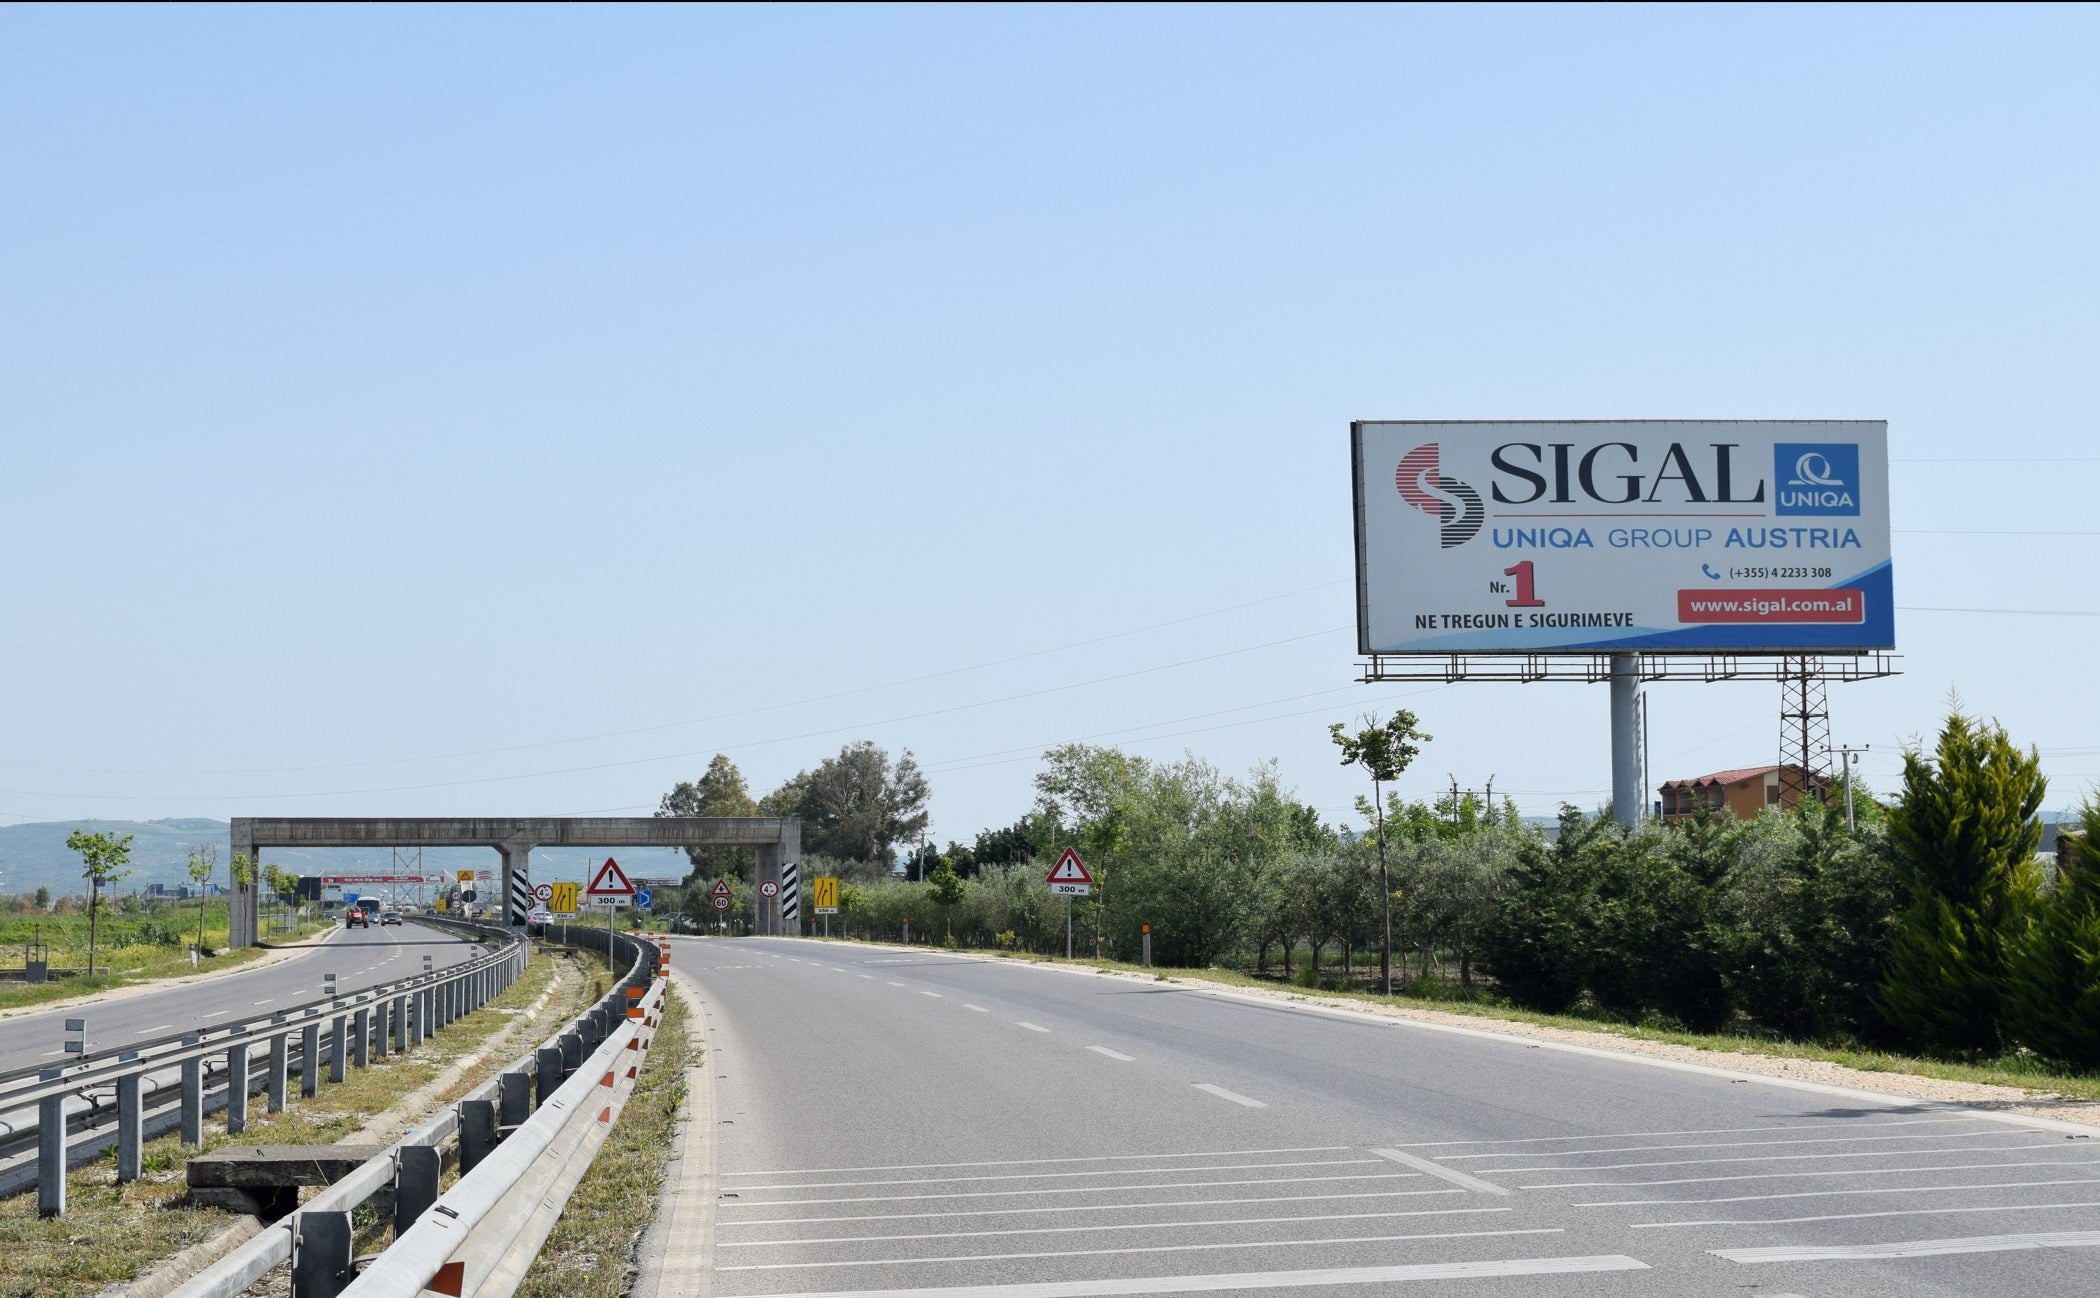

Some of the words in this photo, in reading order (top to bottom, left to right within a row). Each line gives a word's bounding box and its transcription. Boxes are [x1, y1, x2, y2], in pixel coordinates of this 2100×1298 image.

[1491, 442, 1765, 504] SIGAL
[1780, 491, 1854, 507] UNIQA
[1492, 527, 1594, 549] UNIQA
[1608, 528, 1712, 548] GROUP
[1724, 527, 1862, 549] AUSTRIA
[1729, 566, 1769, 579] (+355)
[1771, 567, 1779, 578] 4
[1781, 567, 1808, 578] 2233
[1811, 567, 1832, 578] 308
[1489, 581, 1510, 594] Nr.
[1504, 560, 1546, 608] 1
[1690, 597, 1852, 616] www.sigal.com.al
[1415, 614, 1437, 629] NE
[1441, 613, 1509, 629] TREGUN
[1514, 613, 1523, 628] E
[1529, 612, 1634, 628] SIGURIMEVE
[1058, 885, 1076, 893] 300
[716, 899, 727, 907] 60
